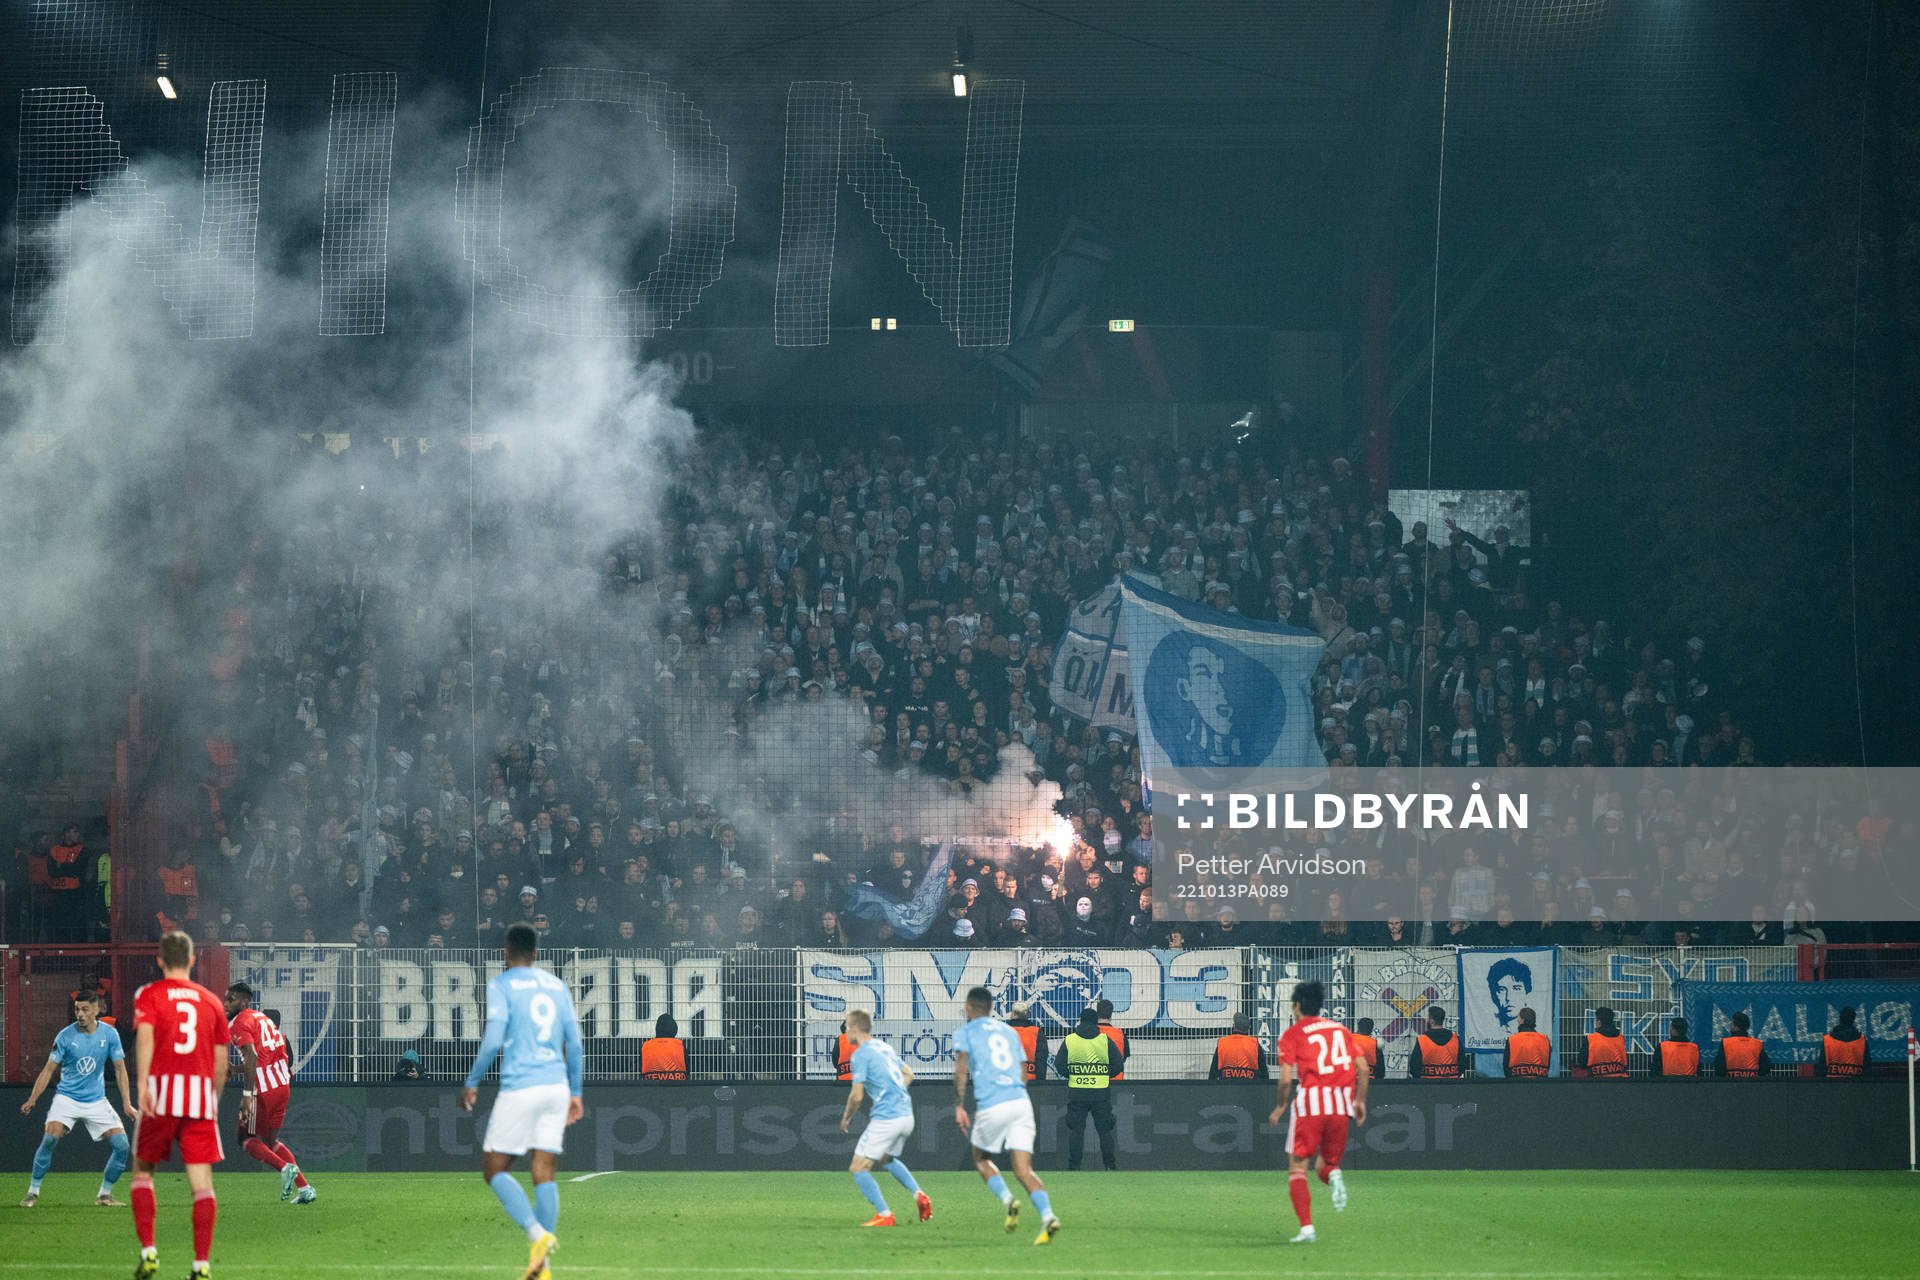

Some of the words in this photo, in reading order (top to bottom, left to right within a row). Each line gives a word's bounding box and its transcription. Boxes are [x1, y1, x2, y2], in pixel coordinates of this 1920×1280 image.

[246, 967, 316, 989] MFF
[378, 956, 724, 1041] BRADA
[174, 1001, 197, 1055] 3
[530, 992, 557, 1043] 9
[987, 1033, 1013, 1071] 8
[1307, 1030, 1352, 1076] 24
[1075, 1077, 1097, 1086] 023
